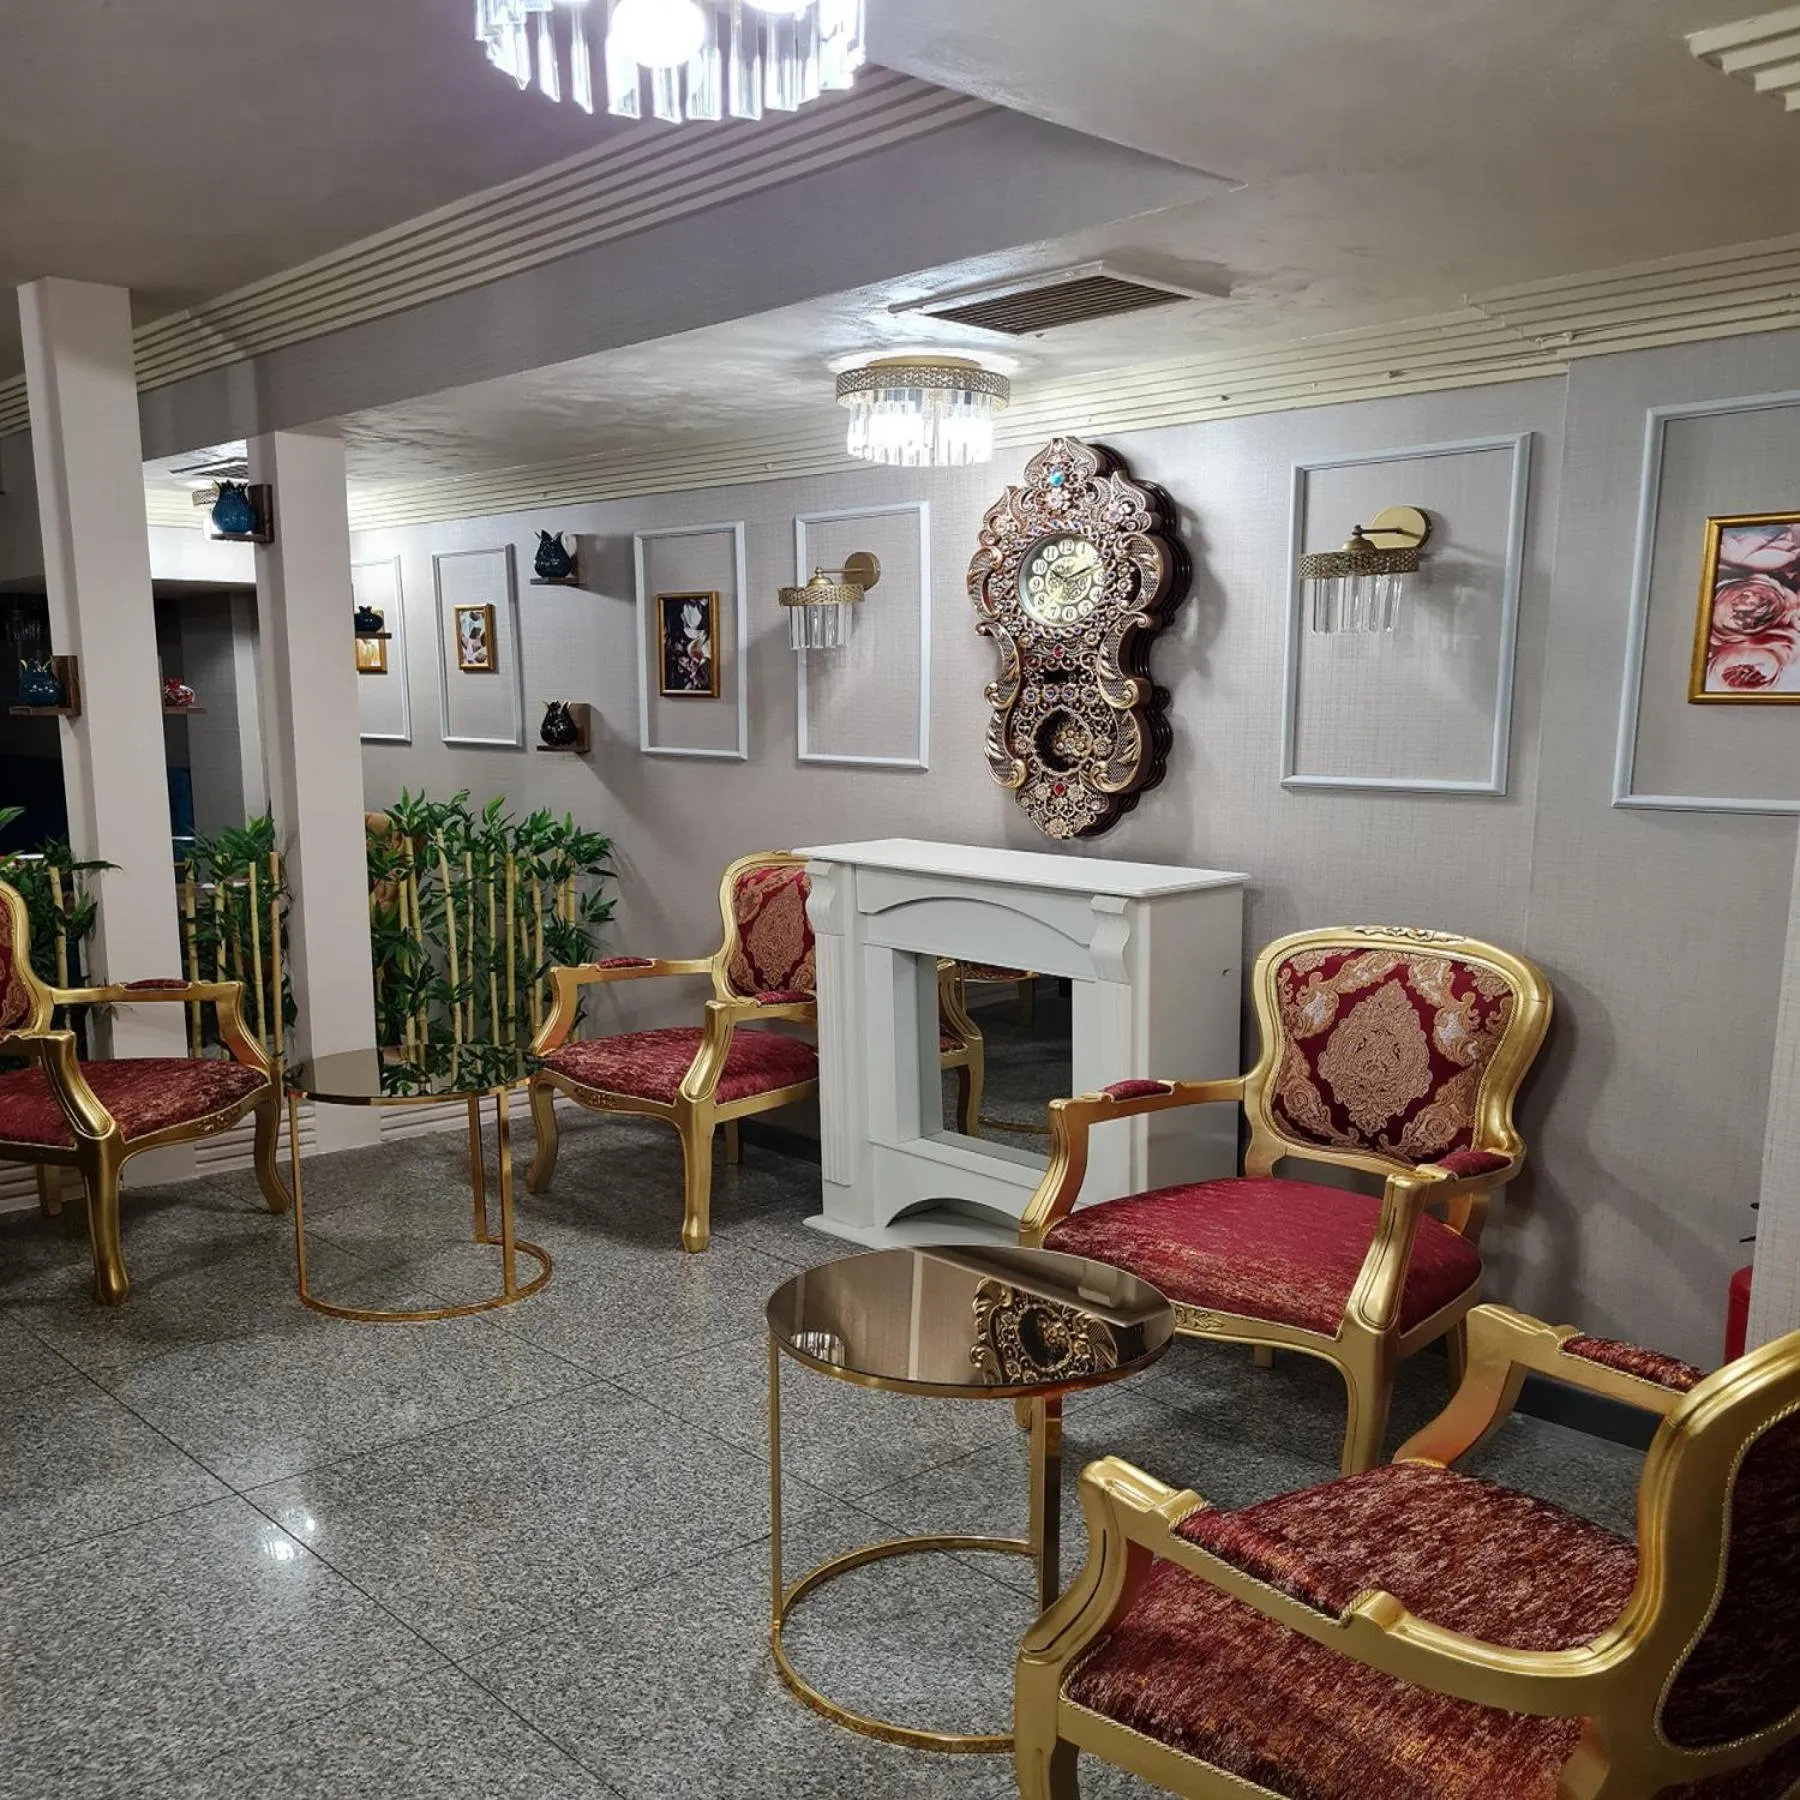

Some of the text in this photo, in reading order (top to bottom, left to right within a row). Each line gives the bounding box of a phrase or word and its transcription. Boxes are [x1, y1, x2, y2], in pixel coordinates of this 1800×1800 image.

[1062, 540, 1073, 552] 12
[1081, 543, 1086, 554] 1
[1046, 548, 1055, 559] 11
[1035, 561, 1045, 572] 10
[1033, 578, 1040, 589] 9
[1038, 595, 1045, 606] 8
[1050, 607, 1057, 617] 7
[1066, 608, 1073, 619] 6
